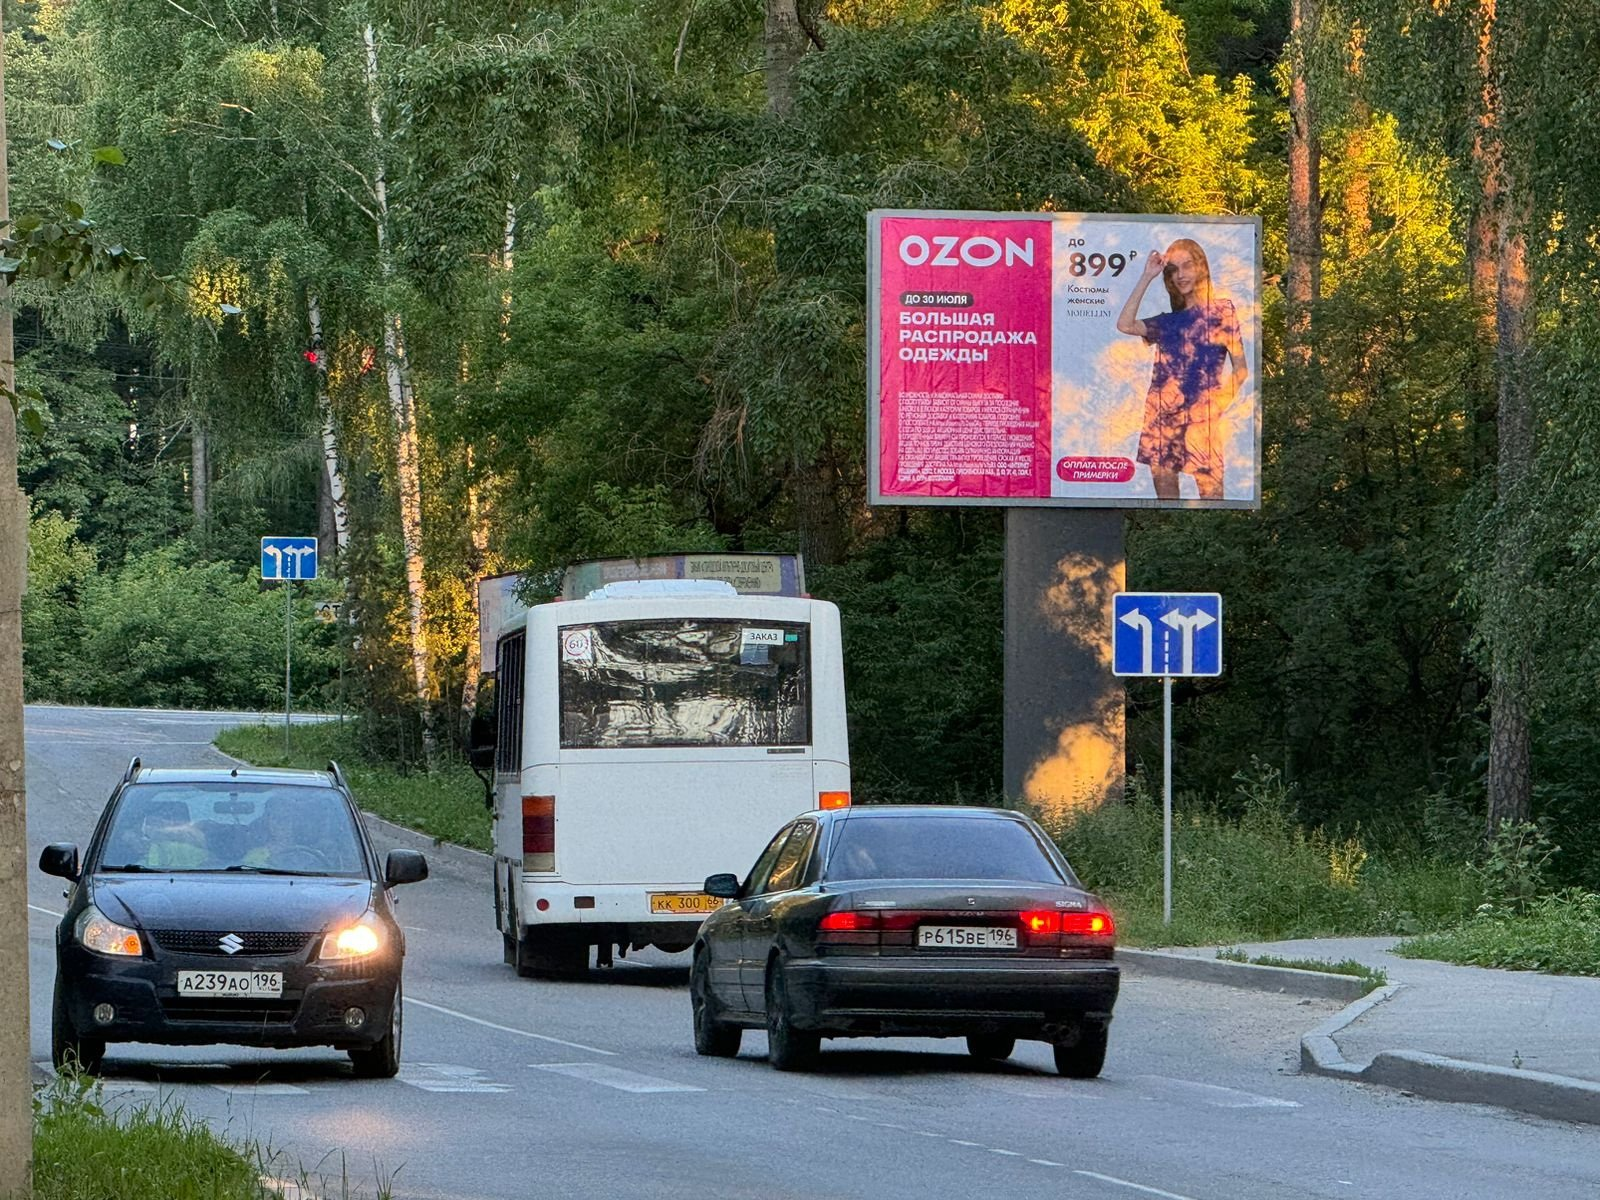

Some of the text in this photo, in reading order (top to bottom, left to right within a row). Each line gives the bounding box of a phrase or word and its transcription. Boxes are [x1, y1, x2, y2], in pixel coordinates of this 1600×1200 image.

[899, 235, 1034, 267] OZON
[1067, 284, 1110, 294] Костюмы
[904, 294, 968, 305] ДО 30 ИЮЛЯ
[899, 311, 995, 326] БОЛЬШАЯ
[899, 329, 1038, 346] РАСПРОДАЖА
[899, 347, 989, 364] ОДЕЖДЫ
[1063, 461, 1129, 470] ОПЛАТА ПОСЛЕ
[1073, 471, 1119, 479] ПРИМЕРКИ
[750, 632, 778, 641] ЗАКАЗ
[678, 897, 700, 908] 300
[924, 928, 1012, 945] Р615ВЕ 196
[183, 974, 277, 990] А239АО 196
